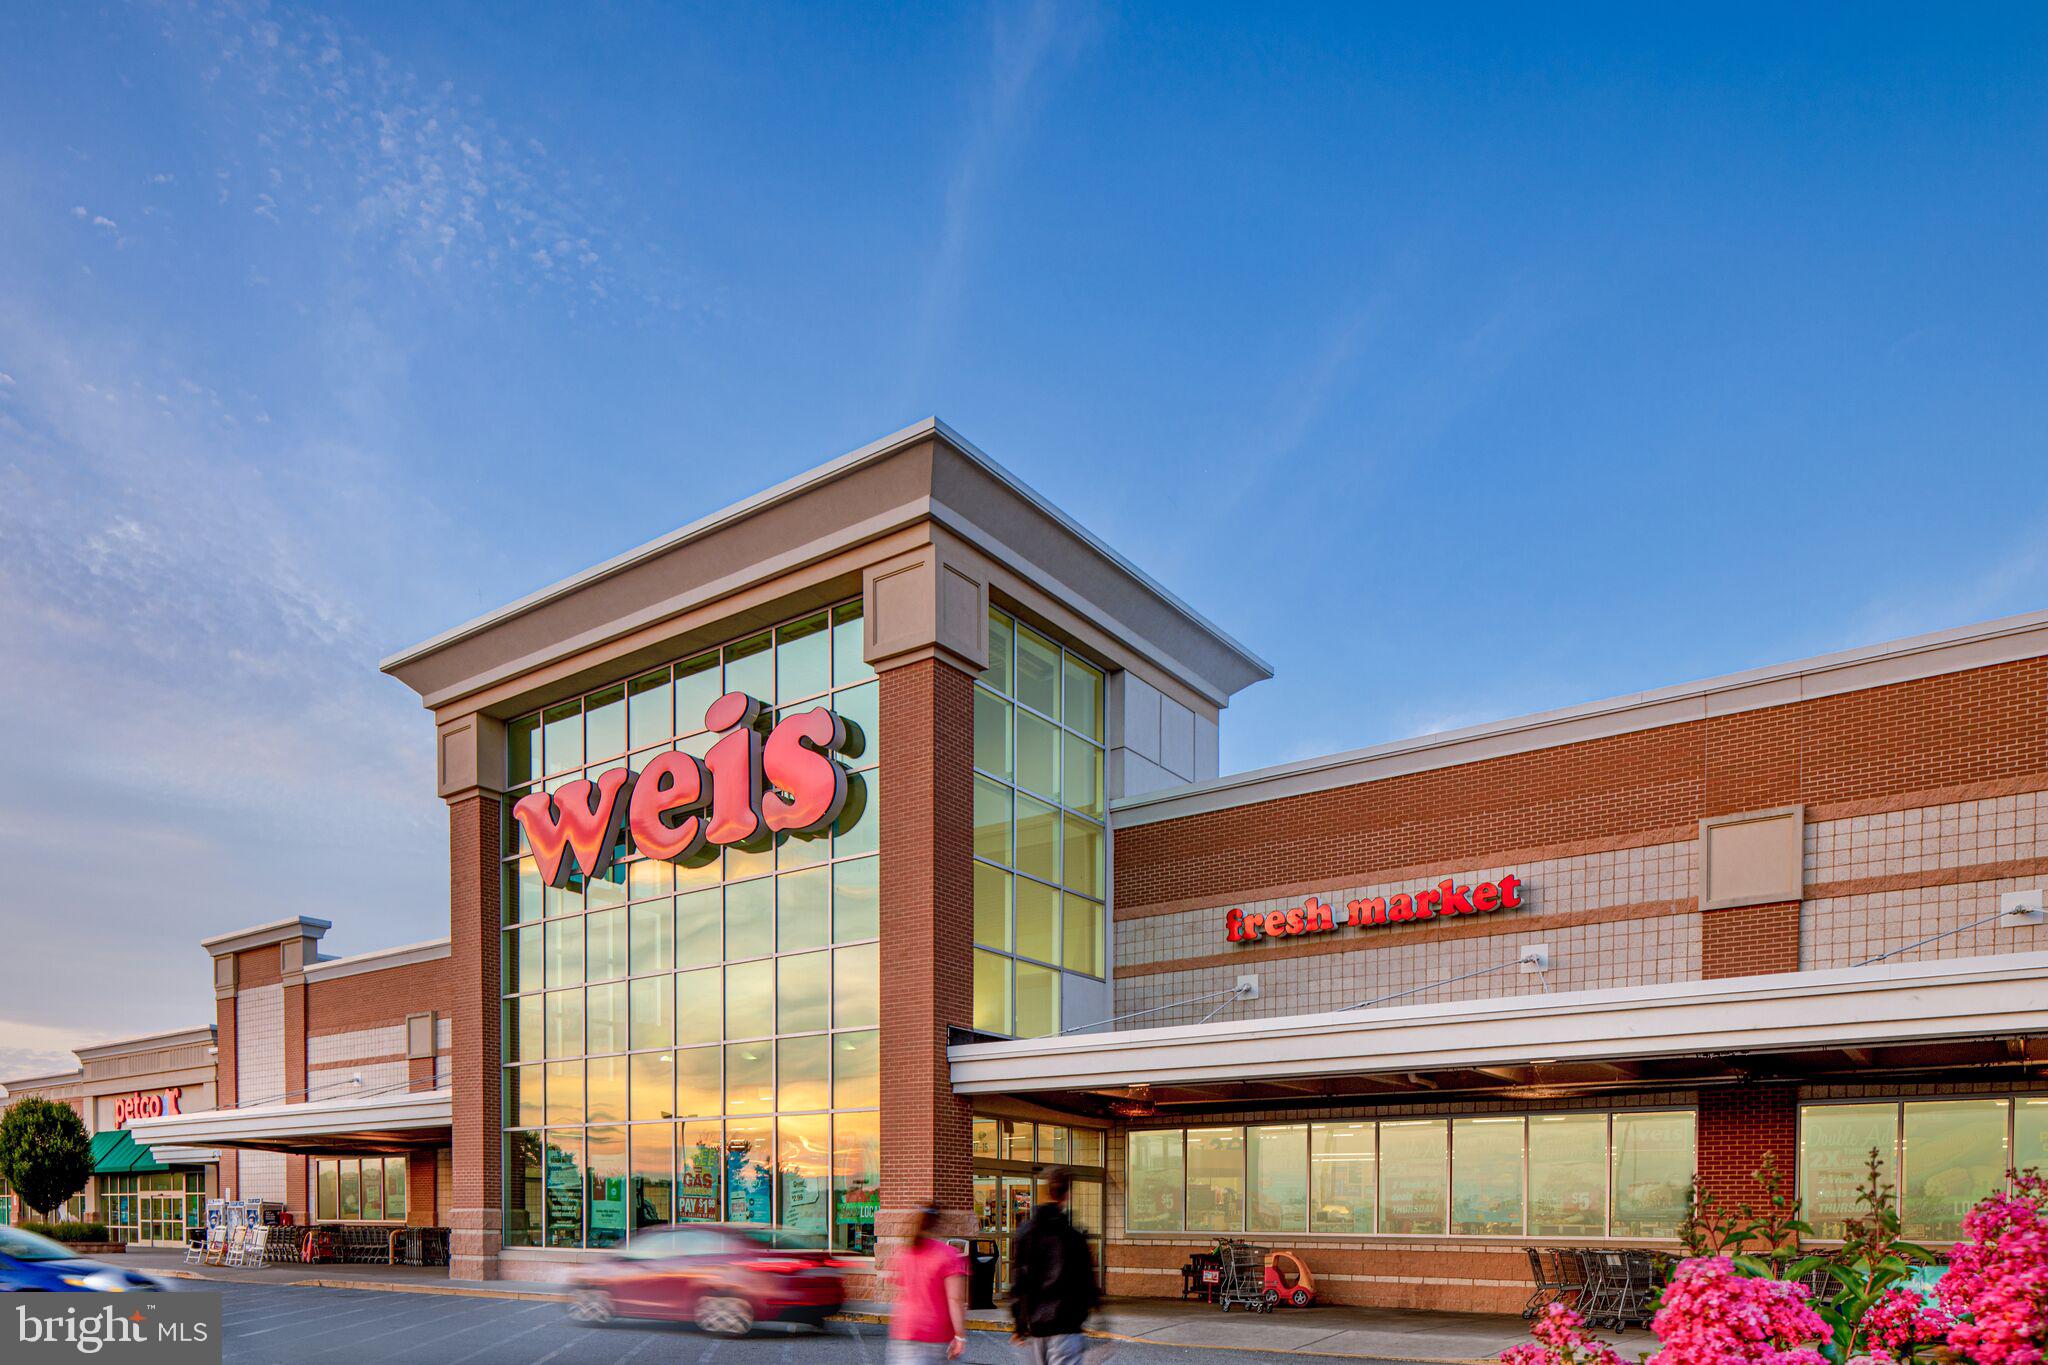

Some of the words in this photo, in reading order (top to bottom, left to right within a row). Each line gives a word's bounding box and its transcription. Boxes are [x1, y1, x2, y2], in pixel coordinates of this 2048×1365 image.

[513, 691, 845, 889] weis
[1226, 897, 1336, 943] fresh
[1347, 874, 1523, 928] market
[115, 1091, 161, 1130] petco
[684, 1172, 712, 1188] GAS
[679, 1198, 696, 1212] PAY
[1161, 1193, 1174, 1209] $5
[1572, 1192, 1590, 1210] $5
